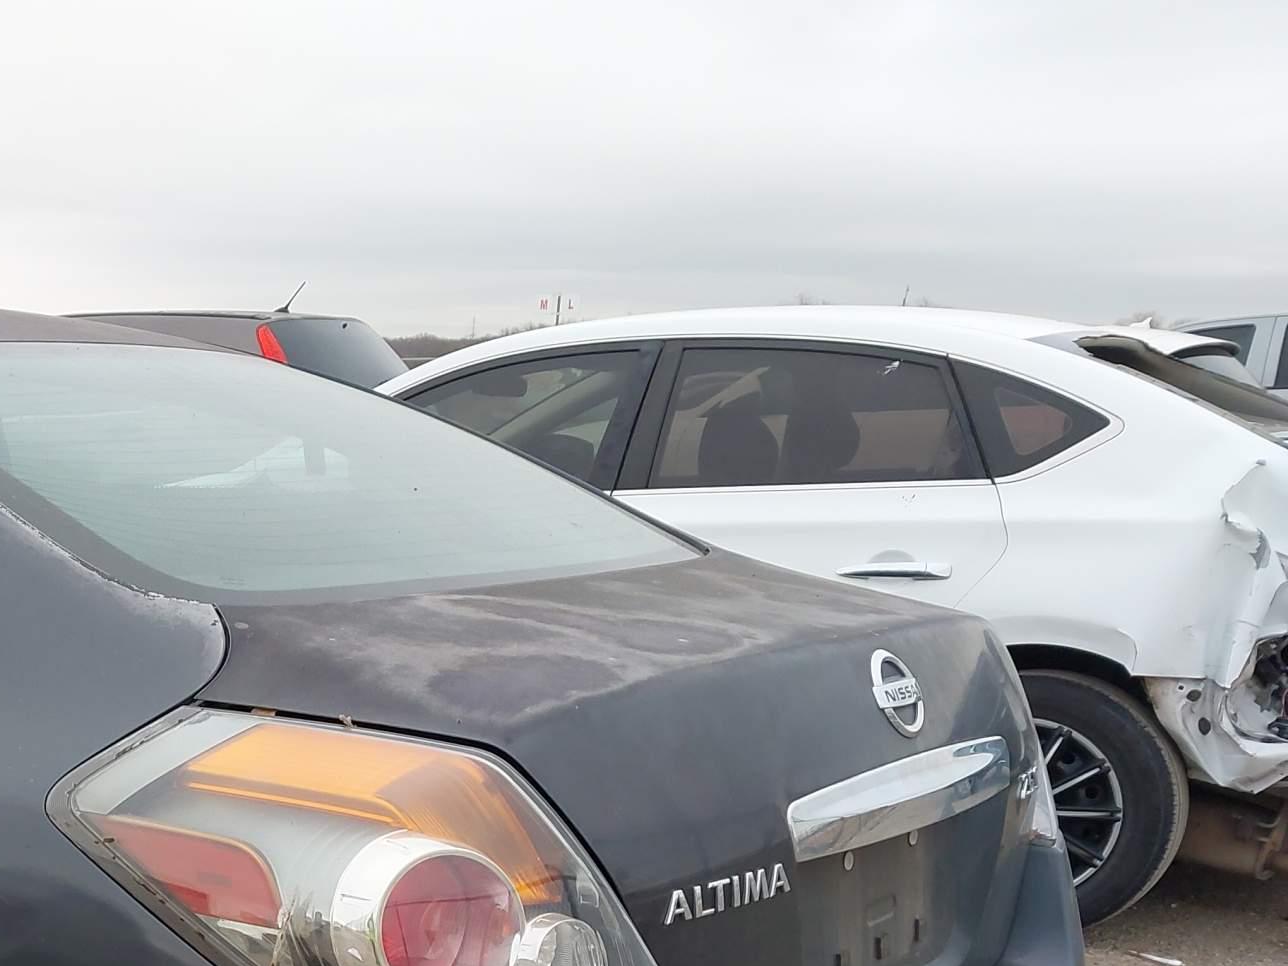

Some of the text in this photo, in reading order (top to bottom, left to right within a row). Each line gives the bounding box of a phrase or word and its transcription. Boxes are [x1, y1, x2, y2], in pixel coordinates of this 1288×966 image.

[539, 298, 549, 311] M
[568, 298, 574, 310] L
[663, 863, 791, 925] ALTIMA
